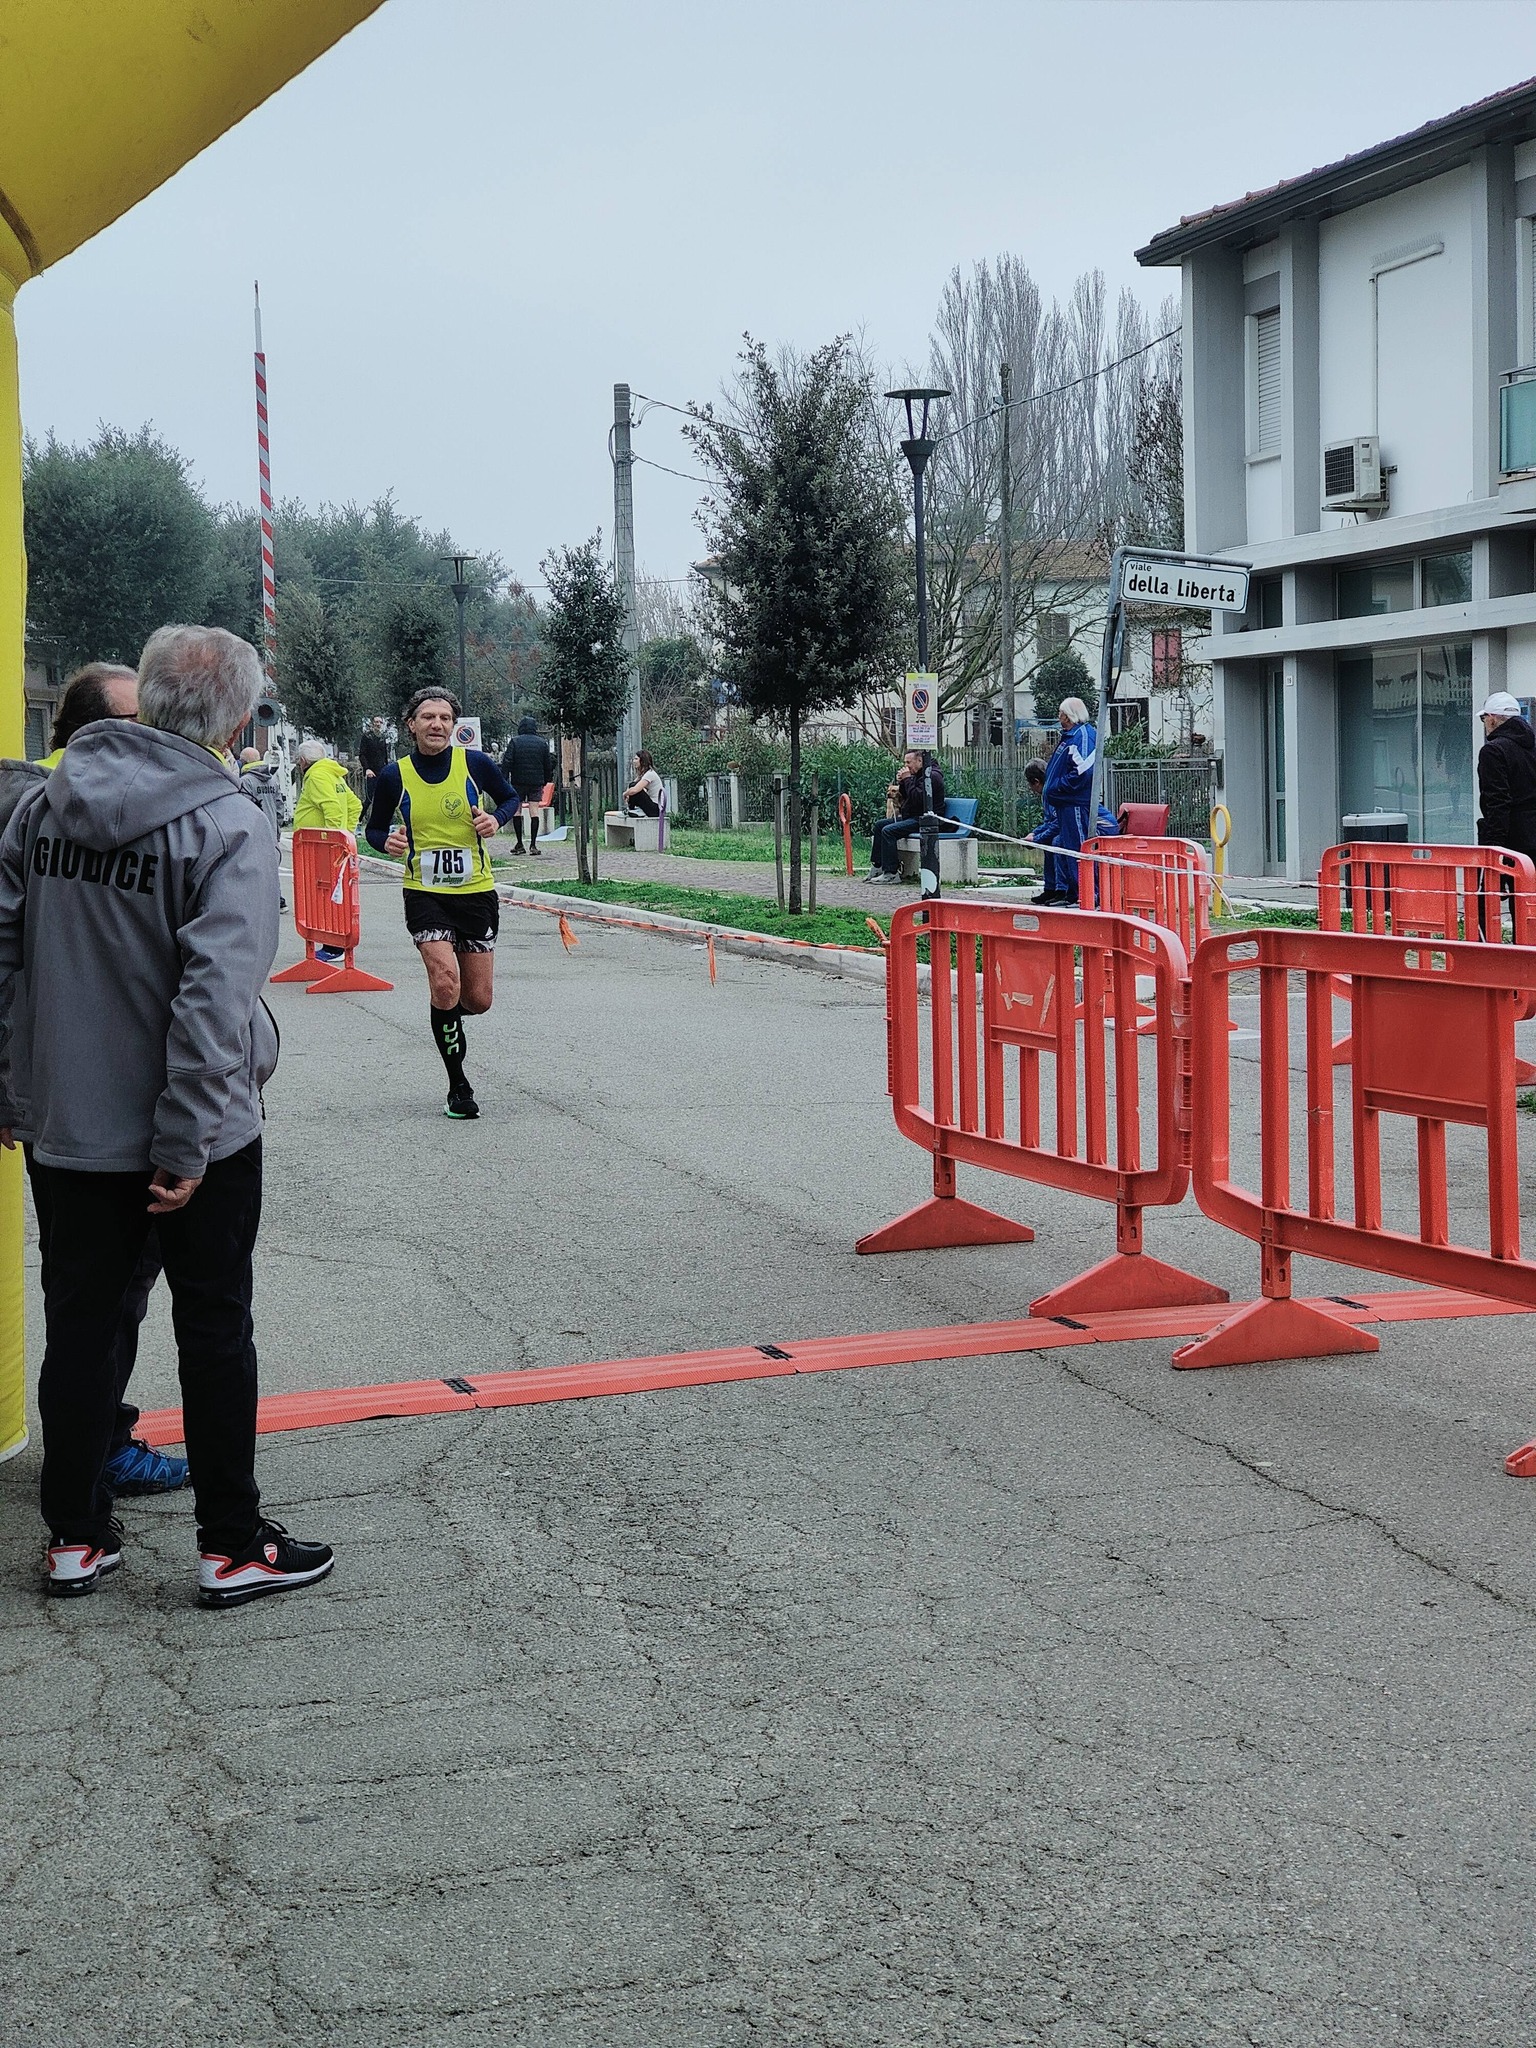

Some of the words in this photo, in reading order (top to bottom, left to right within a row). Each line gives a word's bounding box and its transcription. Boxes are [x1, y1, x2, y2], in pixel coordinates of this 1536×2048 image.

[1130, 562, 1152, 572] viale
[1129, 574, 1169, 595] della
[33, 836, 159, 896] GIUDICE
[432, 849, 464, 875] 785
